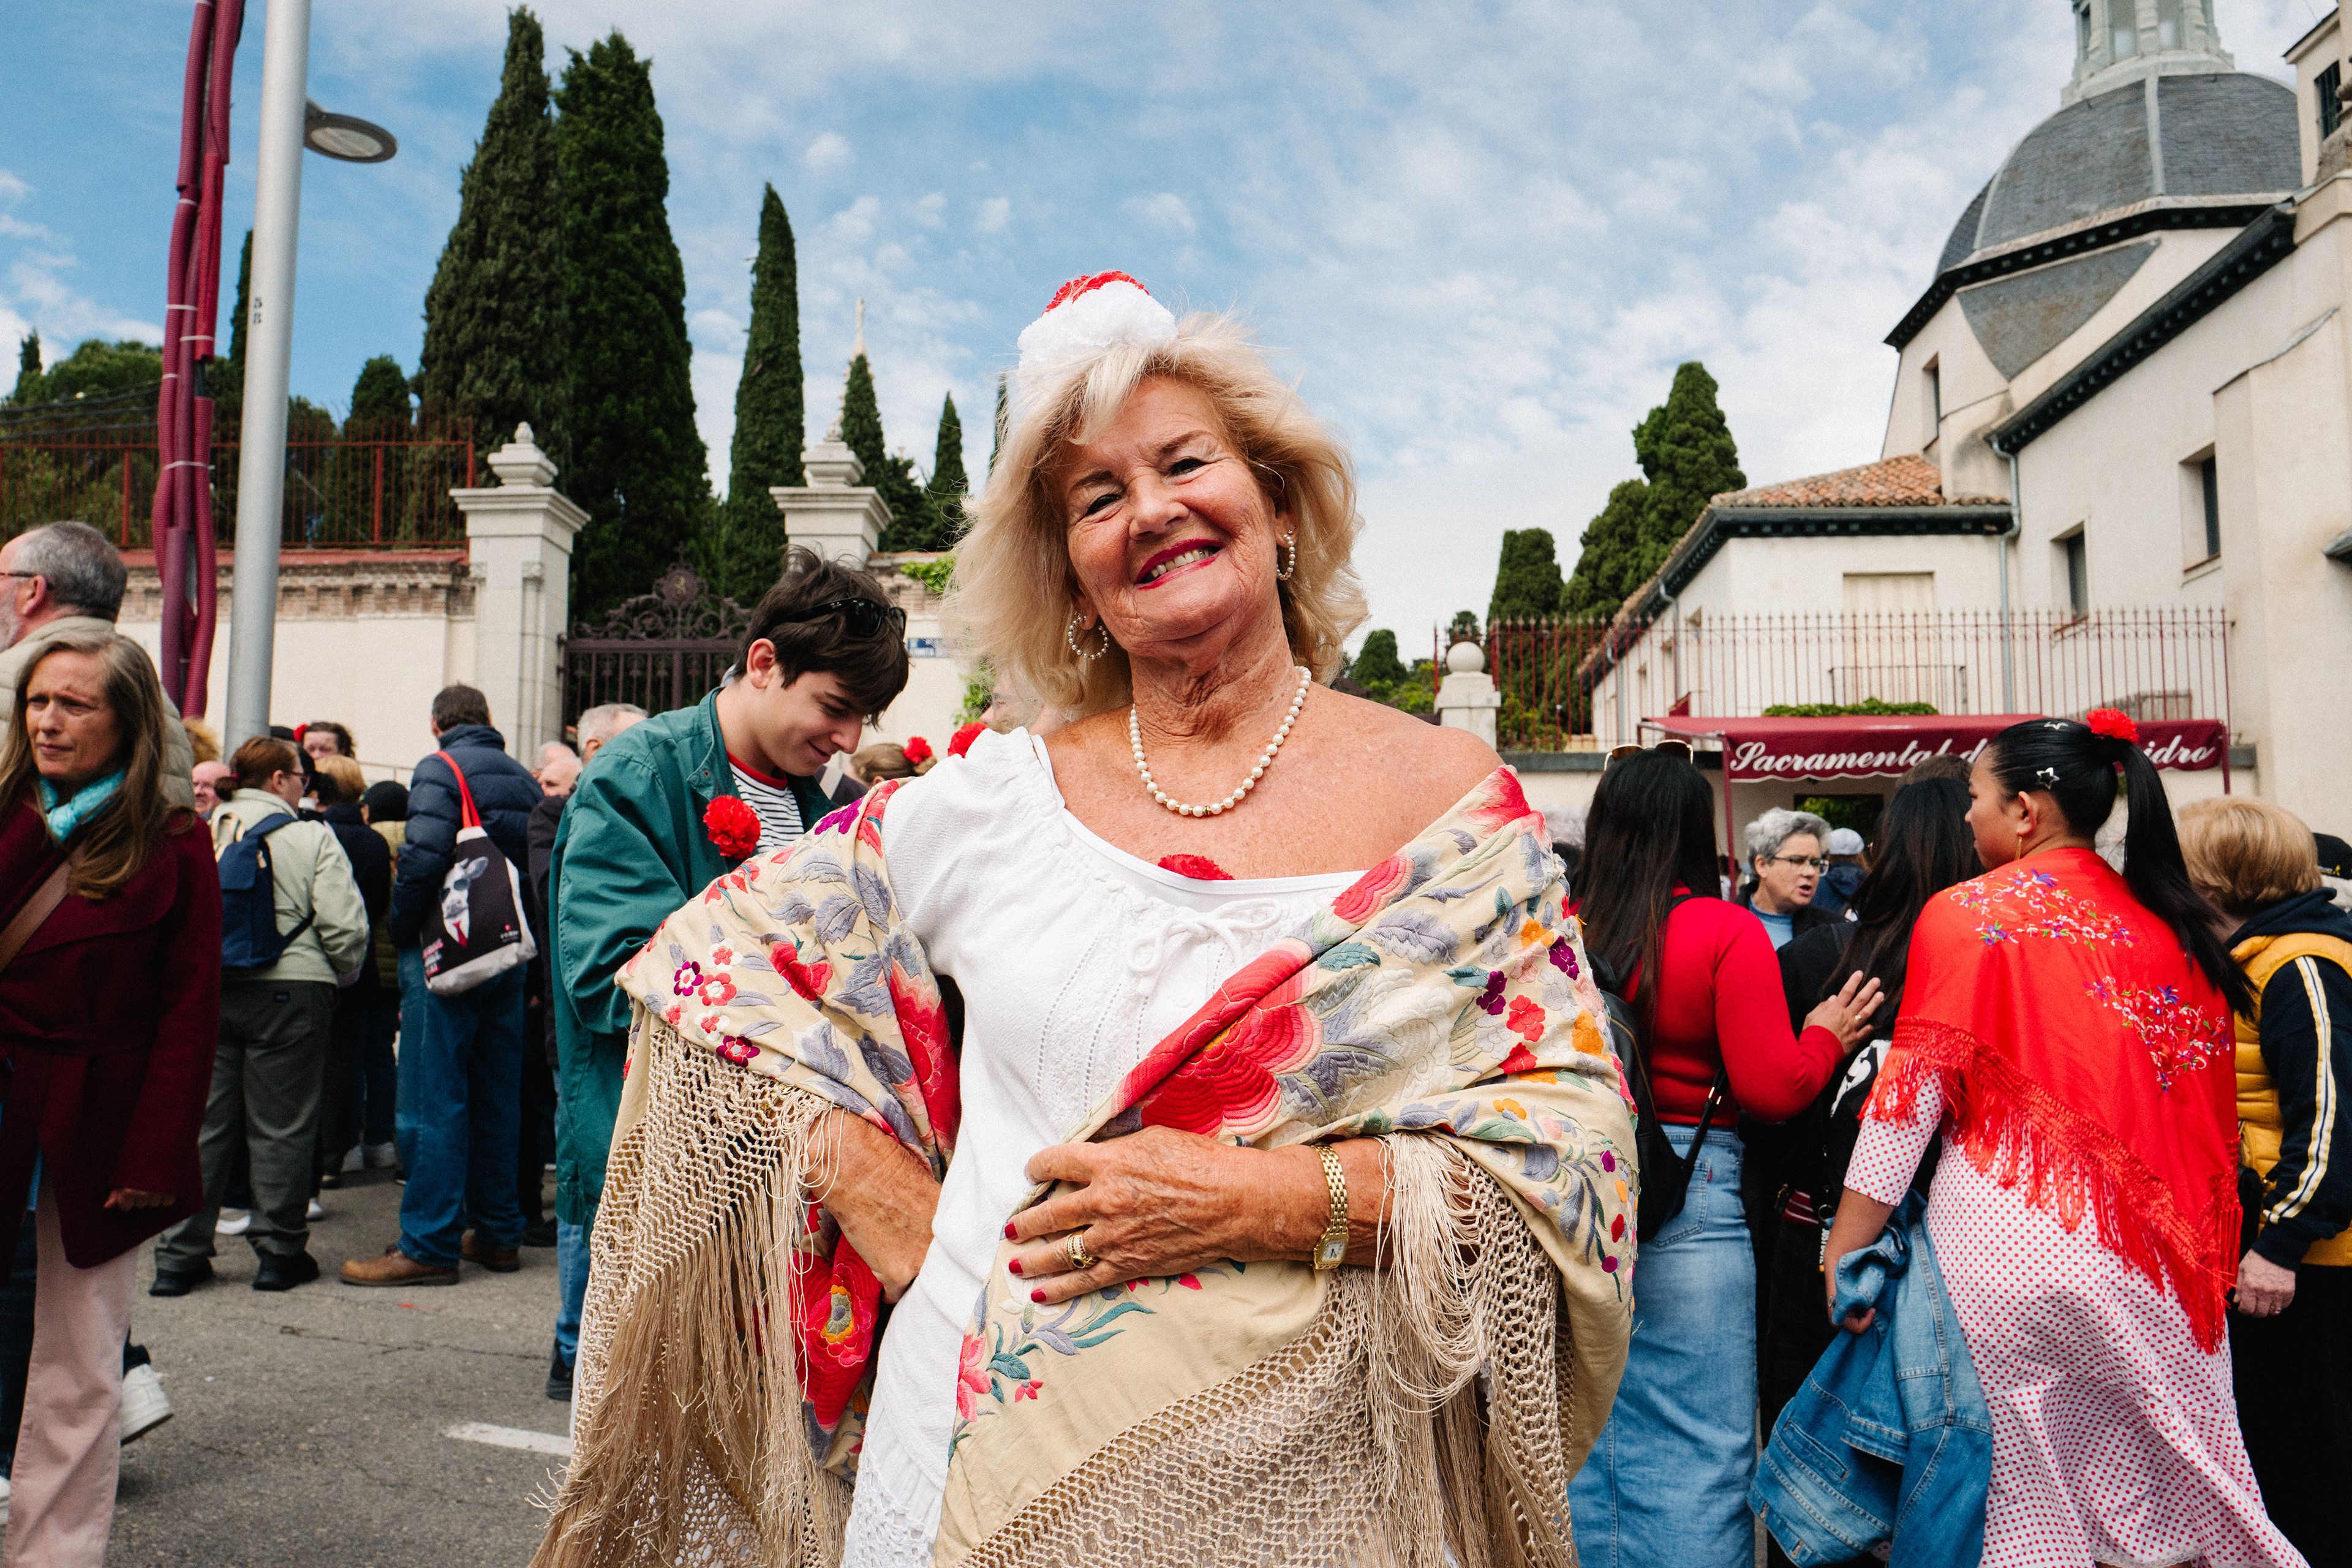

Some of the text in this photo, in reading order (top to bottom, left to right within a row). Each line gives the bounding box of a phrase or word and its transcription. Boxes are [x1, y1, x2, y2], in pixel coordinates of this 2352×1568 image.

[1730, 734, 2216, 772] Sacramental d idro
